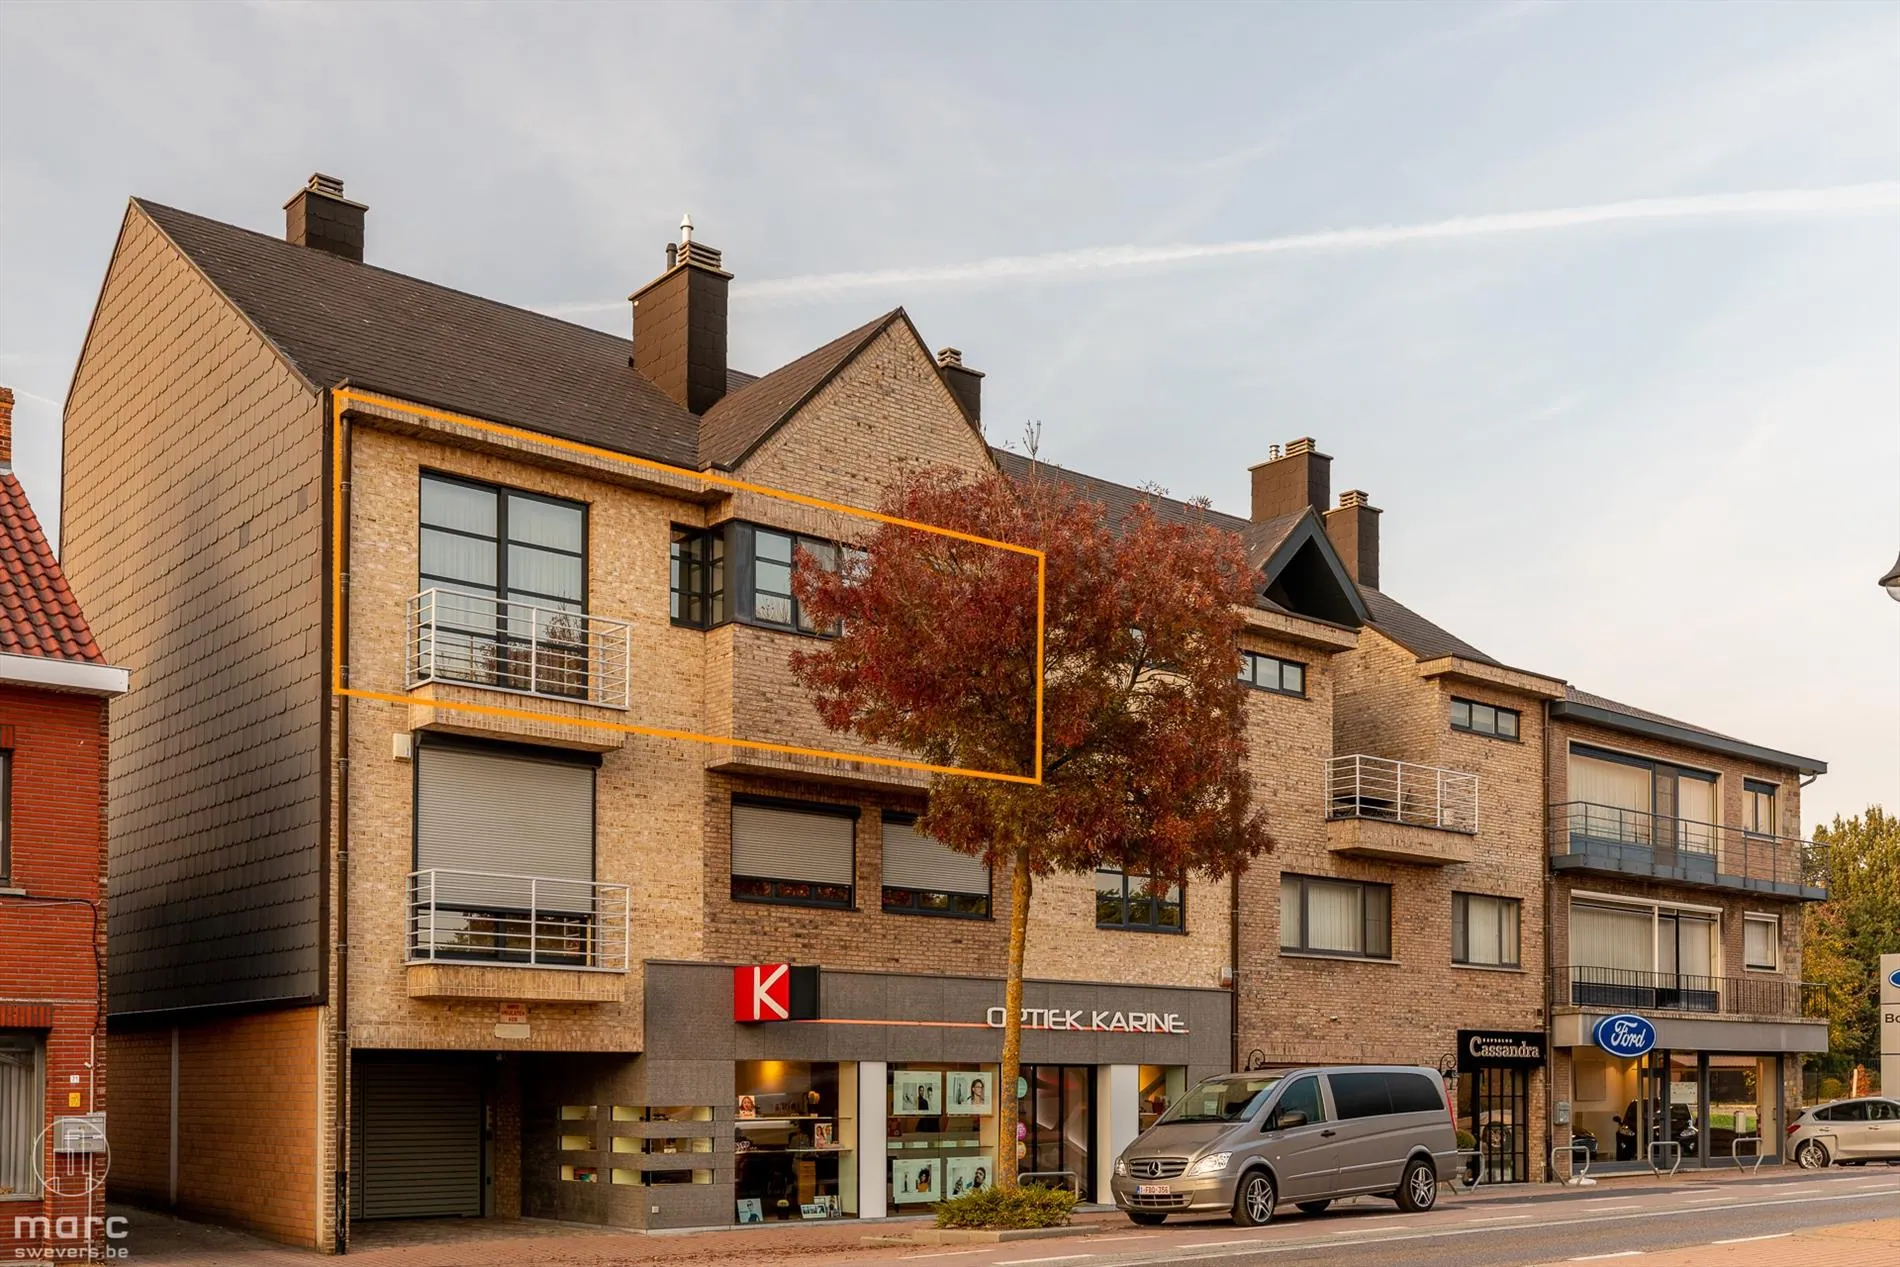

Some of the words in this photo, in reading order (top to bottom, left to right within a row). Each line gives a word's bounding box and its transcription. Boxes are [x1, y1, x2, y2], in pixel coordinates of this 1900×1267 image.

[754, 964, 789, 1020] K
[1092, 1011, 1184, 1033] KARINE
[1611, 1020, 1646, 1047] Ford
[1469, 1036, 1540, 1057] Cassandra
